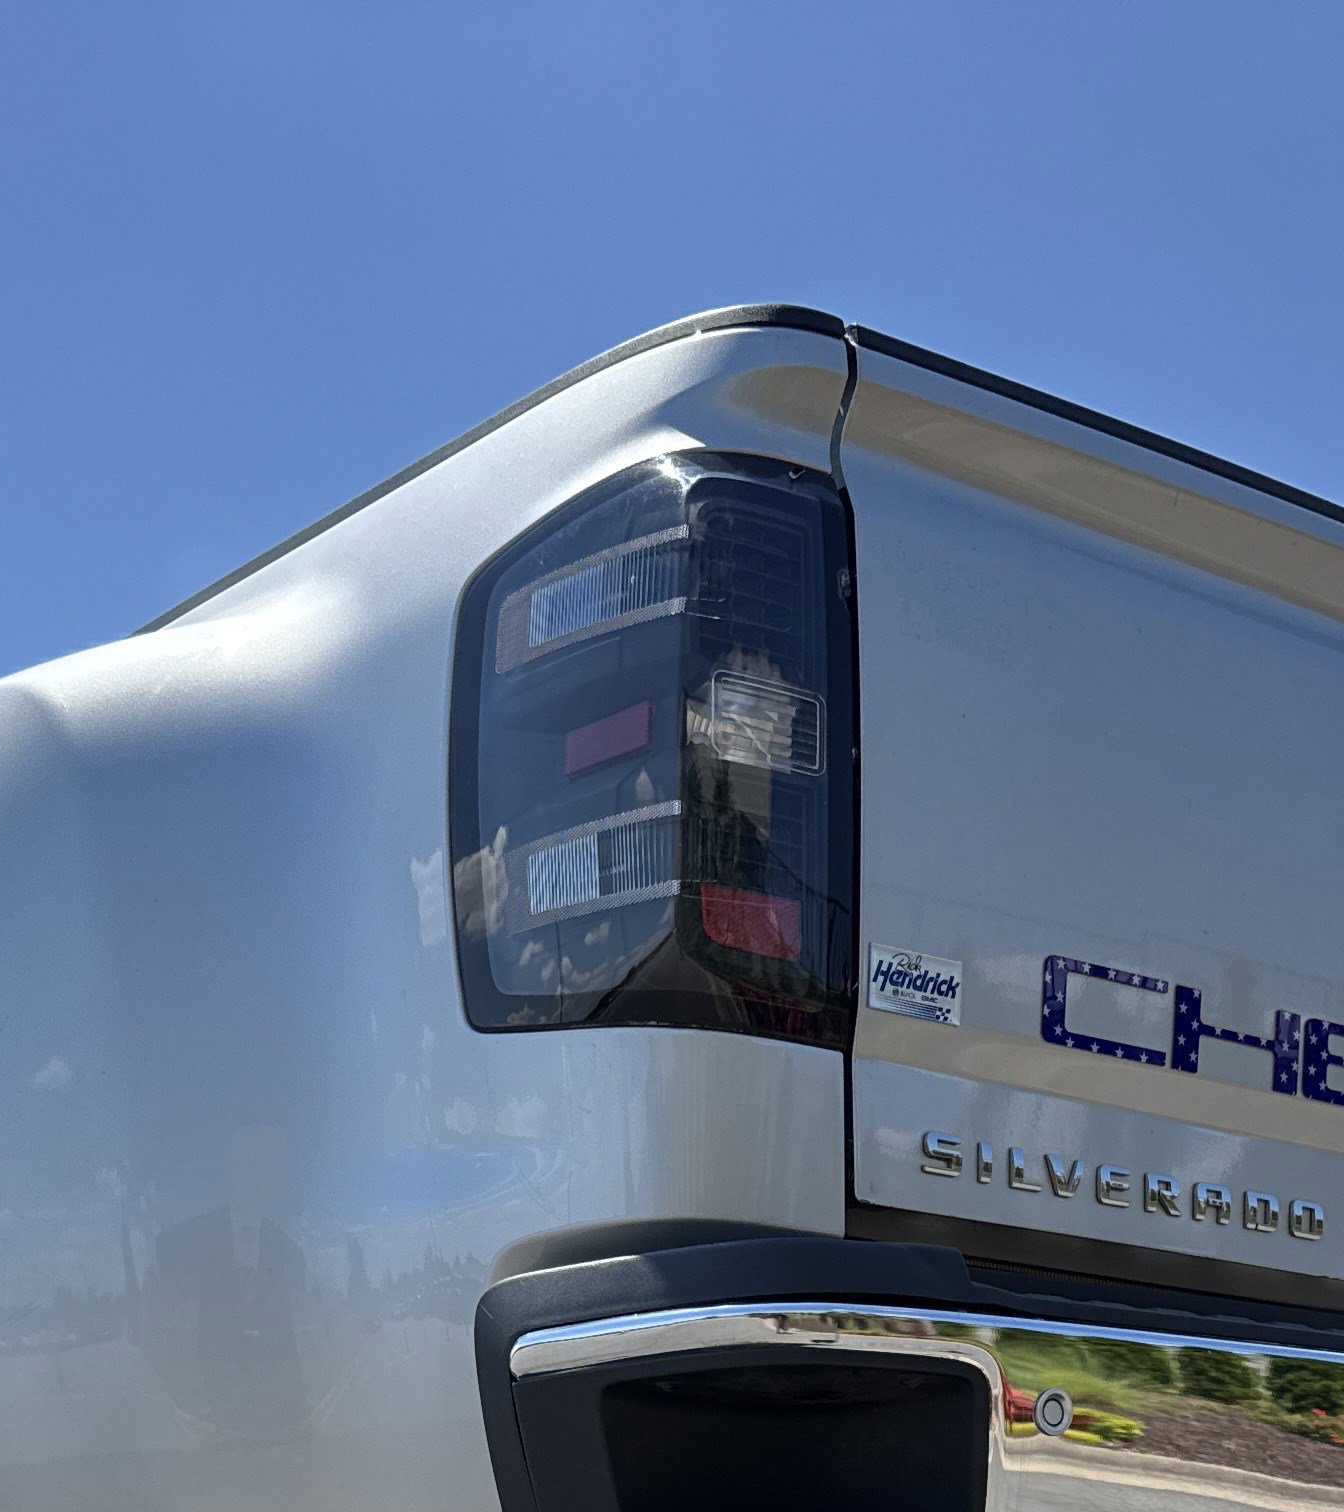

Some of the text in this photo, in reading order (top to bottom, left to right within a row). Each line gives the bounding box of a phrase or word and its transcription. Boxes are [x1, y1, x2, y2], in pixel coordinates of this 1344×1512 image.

[872, 959, 961, 999] Hendrick
[892, 952, 923, 975] Rick
[921, 1130, 1325, 1242] SILVERADO
